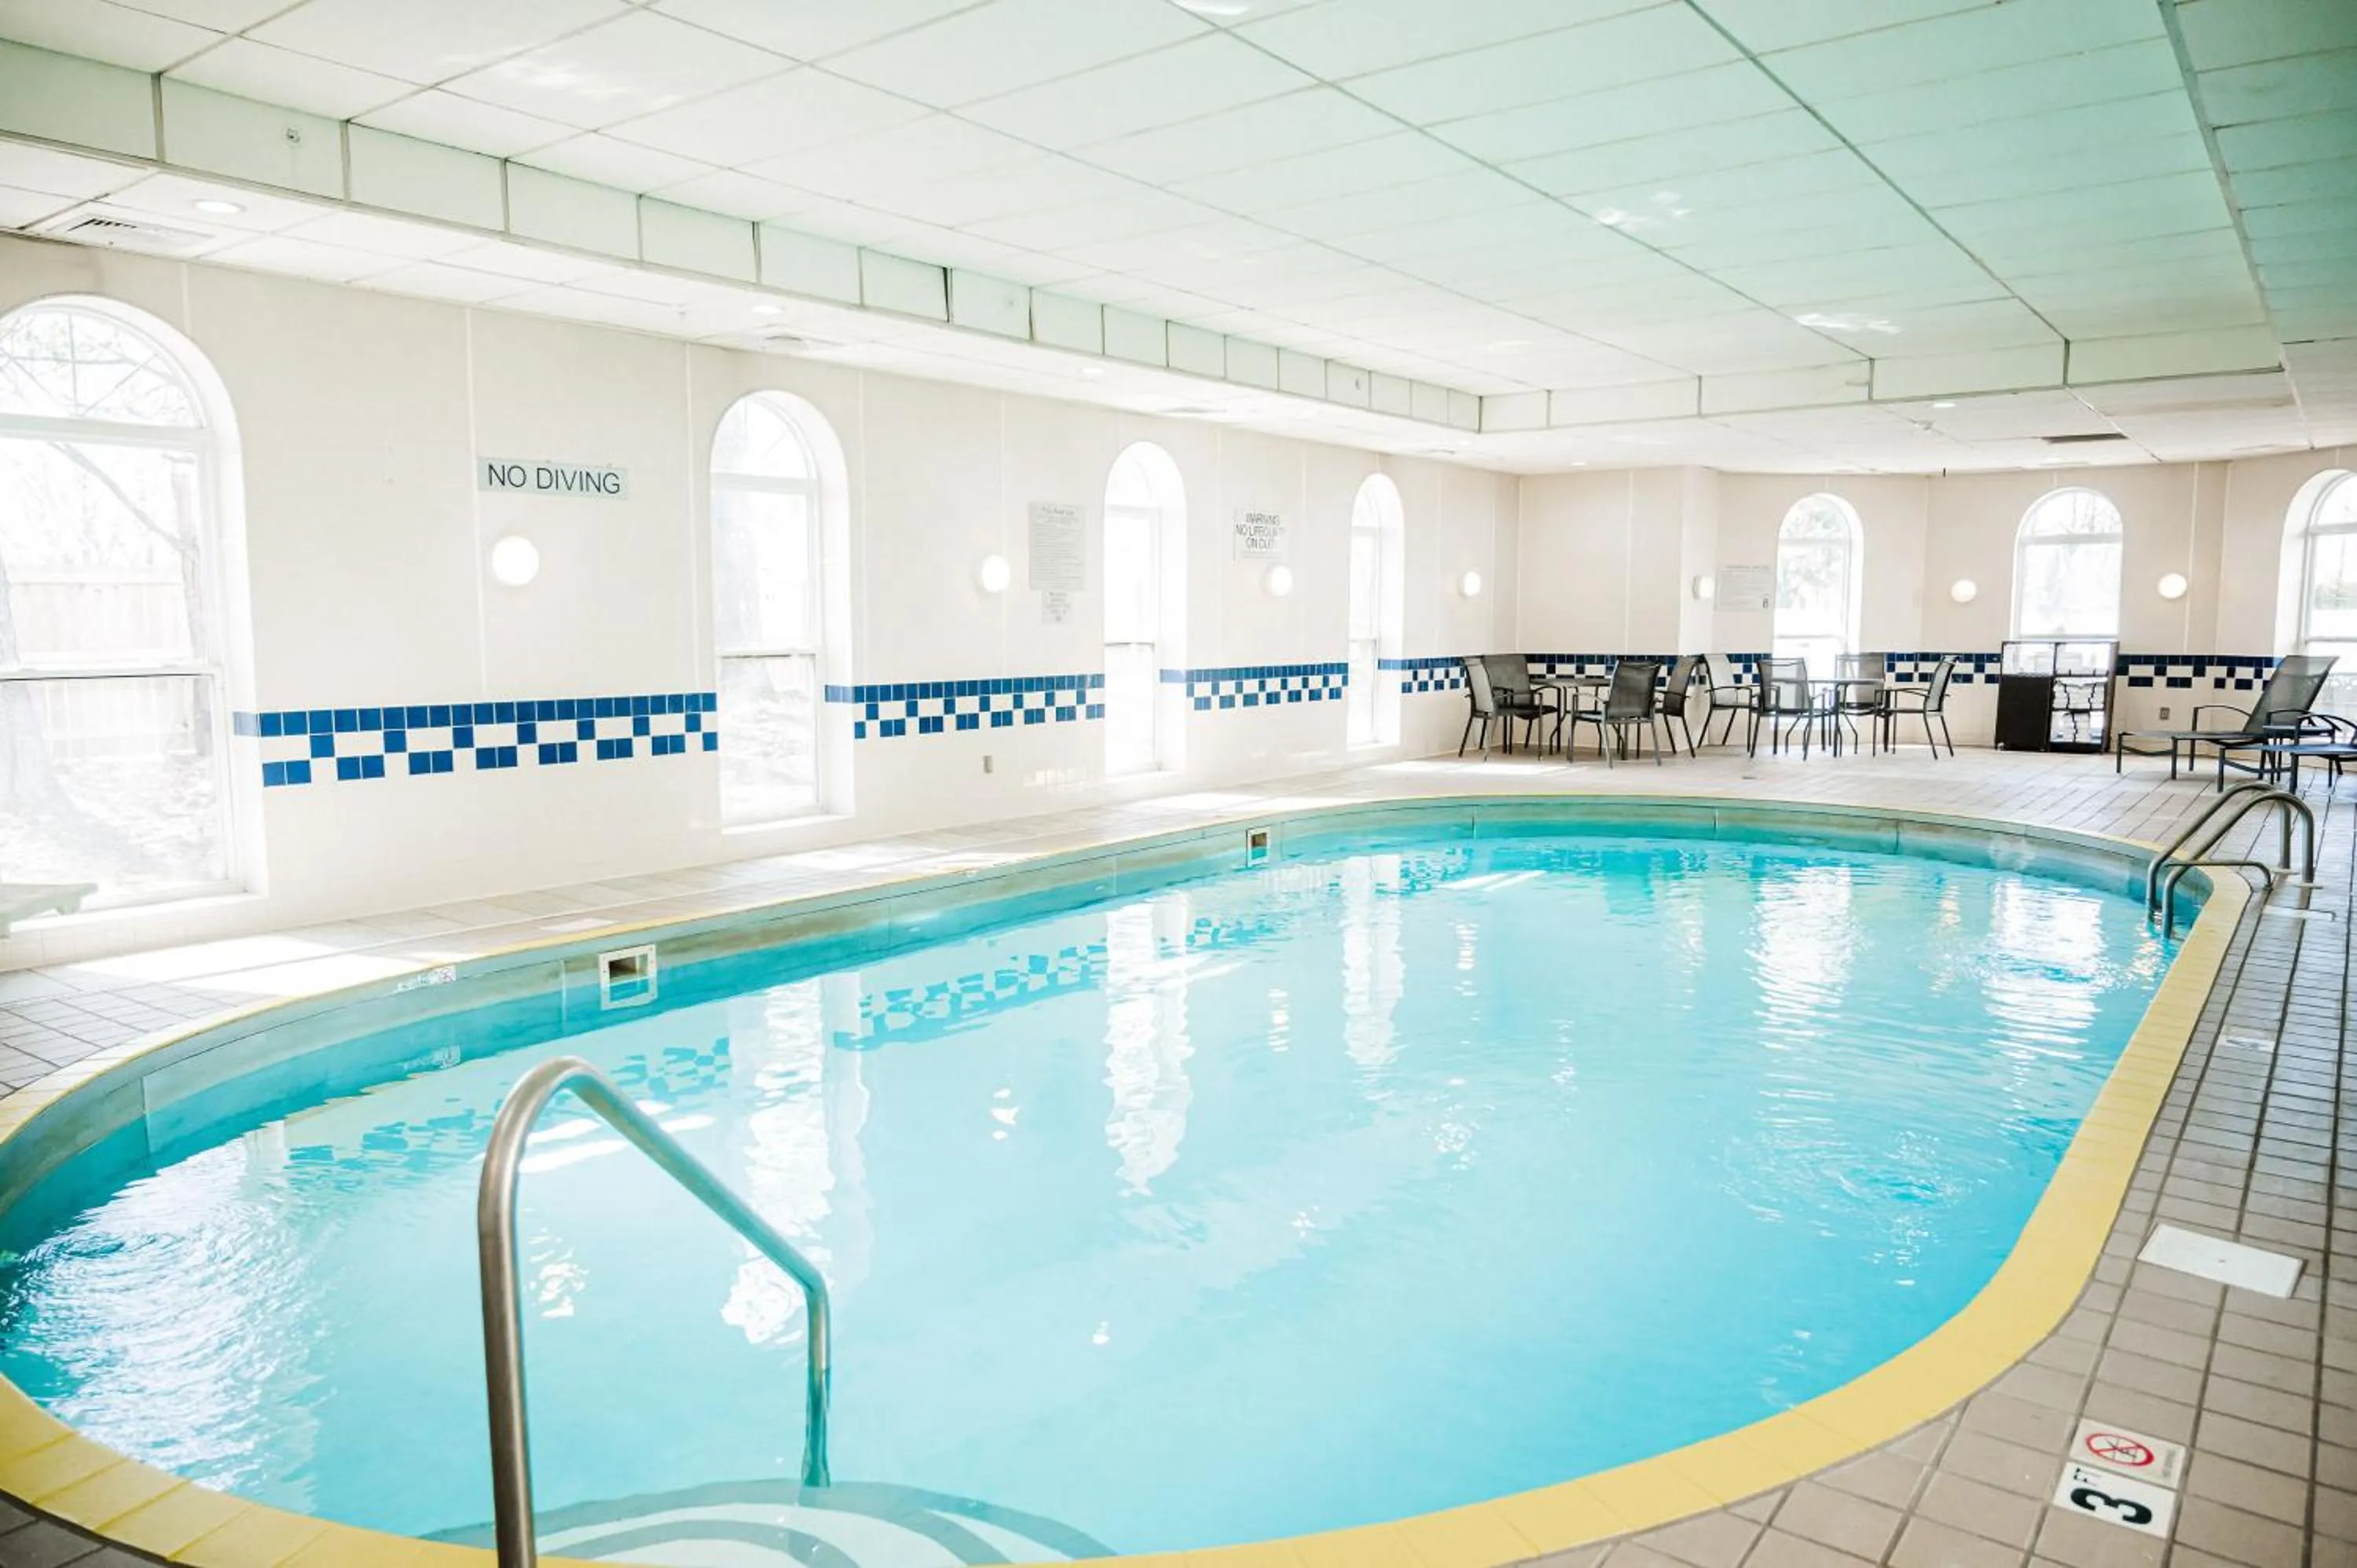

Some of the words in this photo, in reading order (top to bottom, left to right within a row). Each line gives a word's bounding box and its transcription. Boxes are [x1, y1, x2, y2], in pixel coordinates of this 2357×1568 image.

[489, 463, 526, 487] NO
[537, 467, 620, 494] DIVING
[1249, 526, 1286, 537] LIFEGU
[1259, 538, 1277, 549] DUT
[2070, 1487, 2152, 1525] 3
